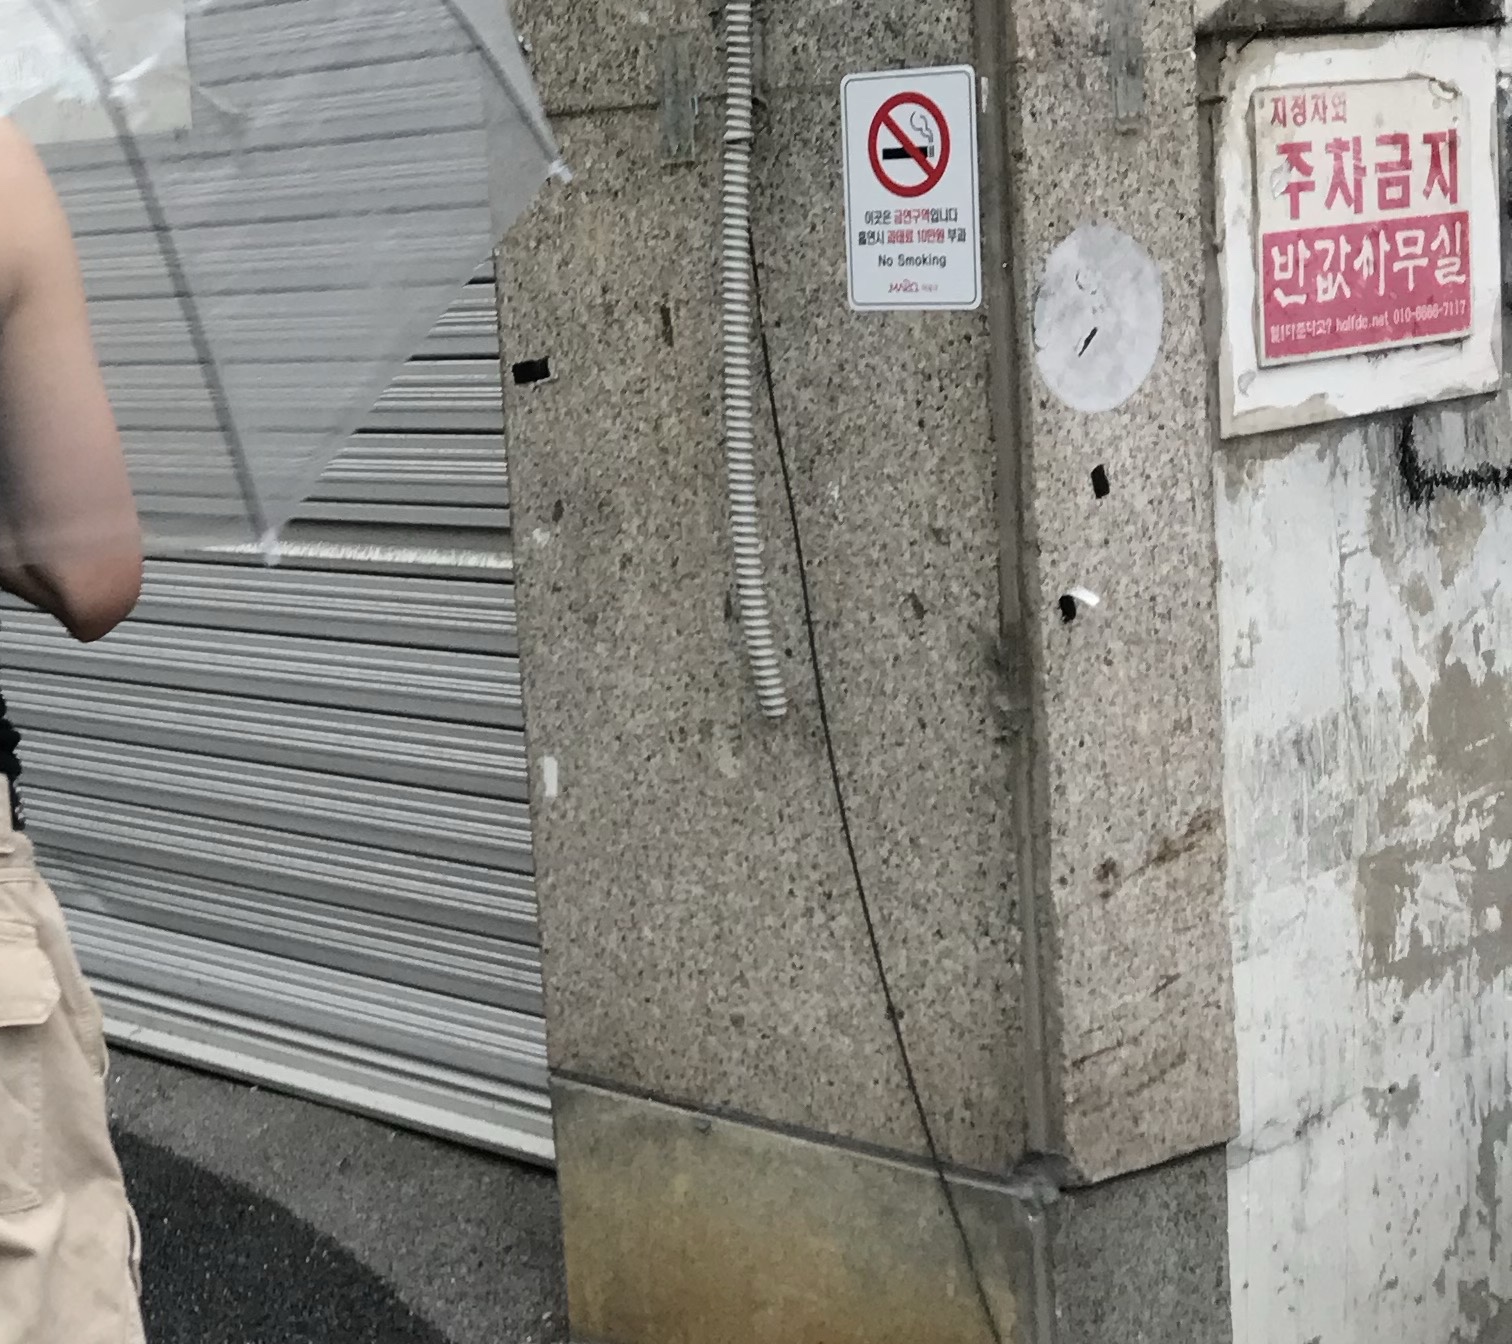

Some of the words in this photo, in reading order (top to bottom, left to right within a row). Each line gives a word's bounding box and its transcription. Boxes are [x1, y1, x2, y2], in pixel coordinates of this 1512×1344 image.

[1276, 129, 1458, 220] 주차금지
[865, 210, 891, 225] 이곳은
[894, 208, 958, 225] 금연구역입니다
[878, 254, 893, 267] No
[898, 253, 946, 268] Smoking
[1271, 221, 1466, 308] 반값사무실
